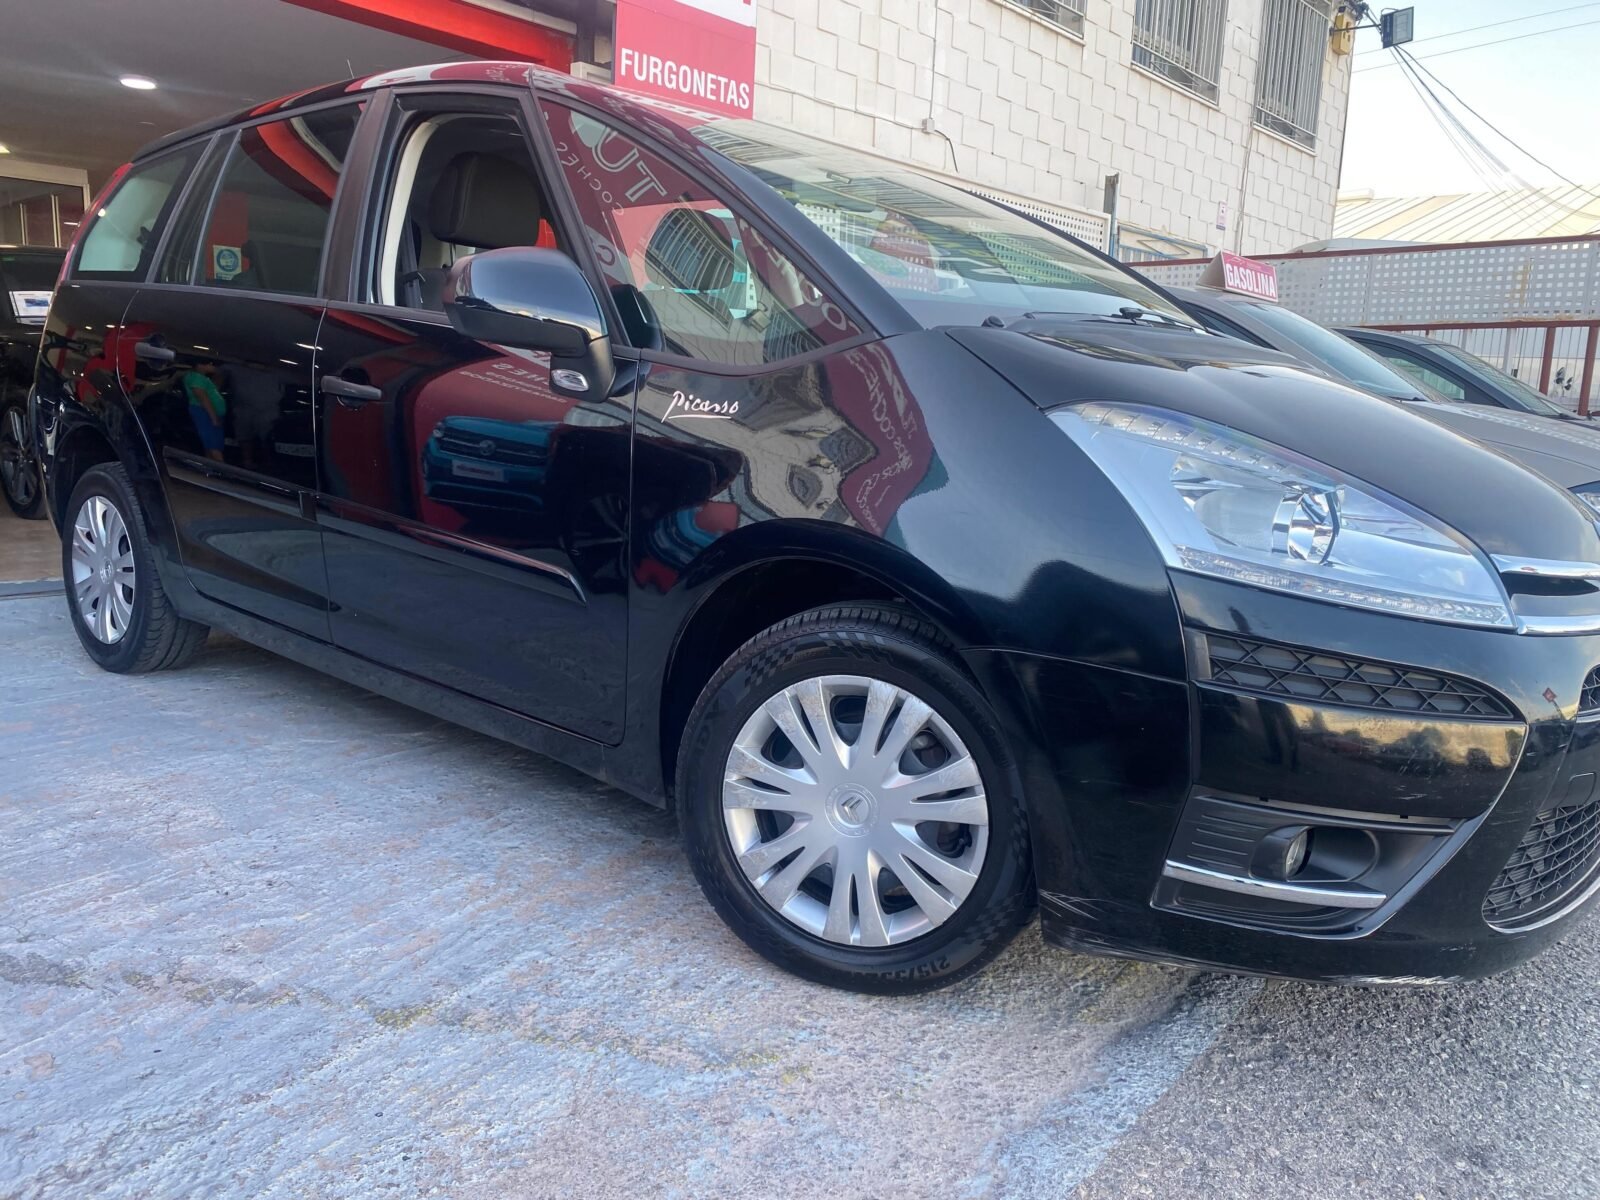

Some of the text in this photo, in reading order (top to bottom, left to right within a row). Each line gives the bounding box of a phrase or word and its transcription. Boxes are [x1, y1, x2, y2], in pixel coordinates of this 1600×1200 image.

[620, 47, 750, 110] FURGONETAS
[1225, 263, 1276, 298] GASOLINA
[660, 390, 739, 424] Picasso
